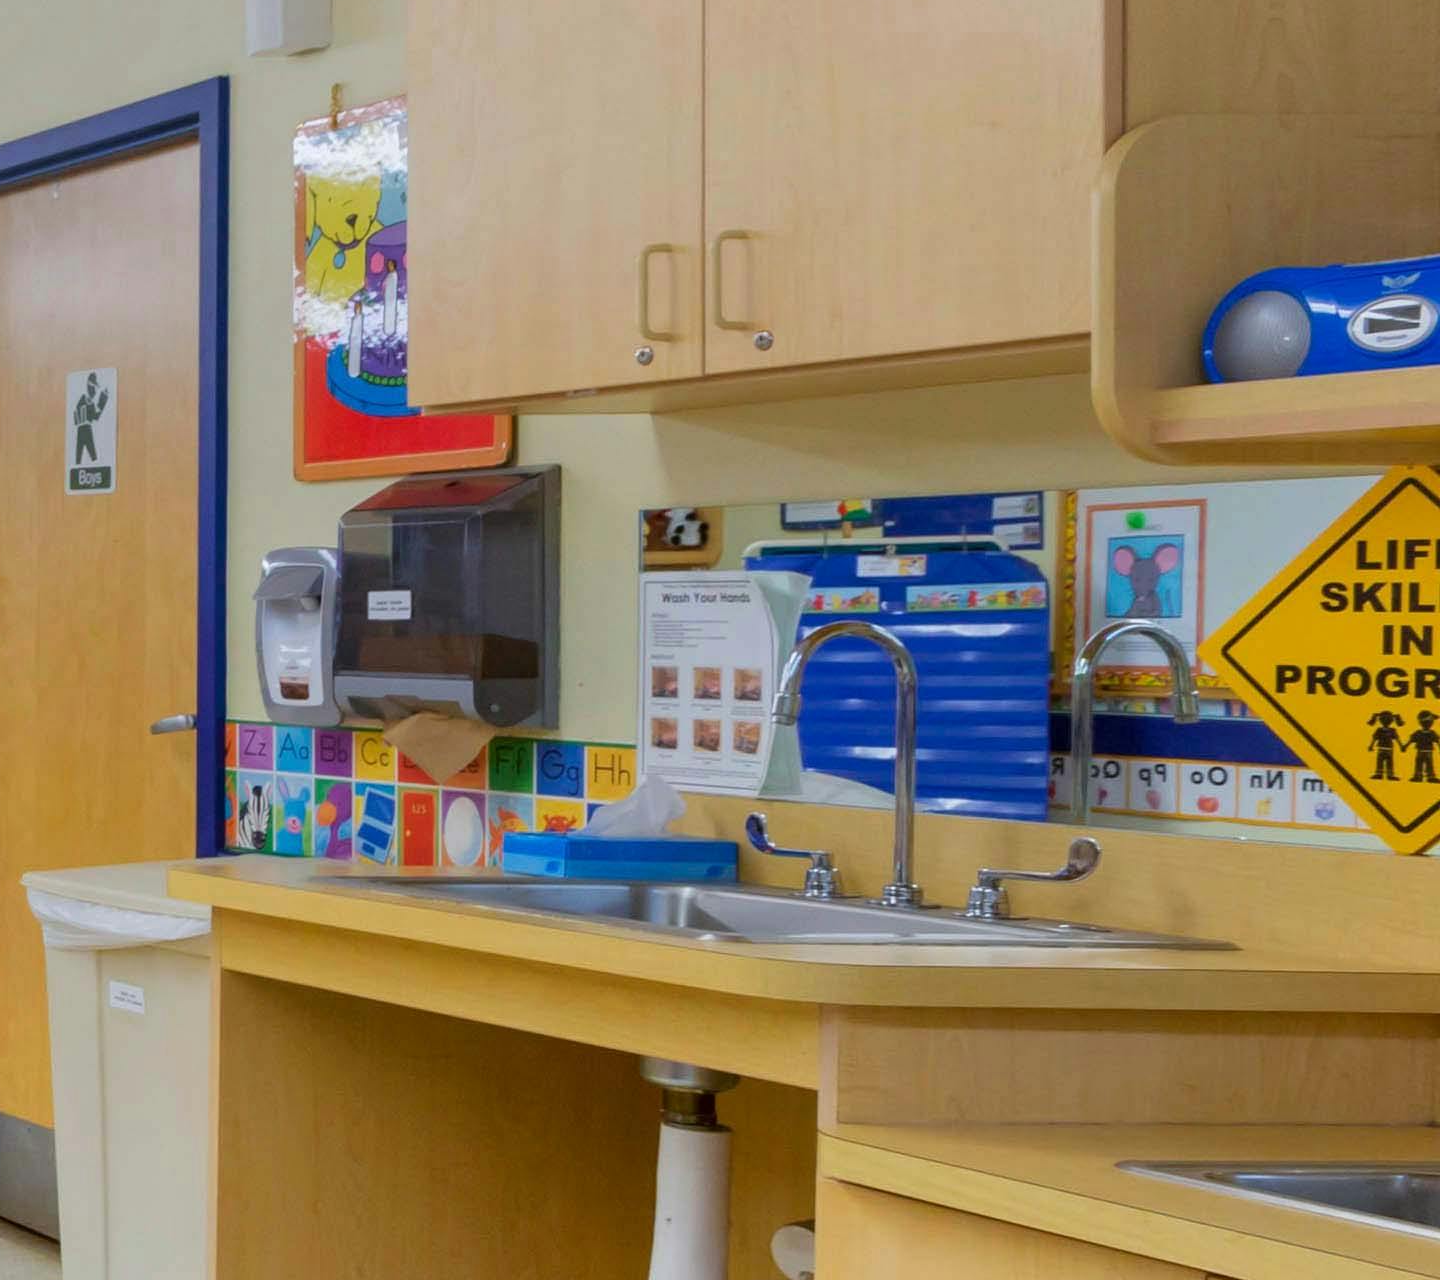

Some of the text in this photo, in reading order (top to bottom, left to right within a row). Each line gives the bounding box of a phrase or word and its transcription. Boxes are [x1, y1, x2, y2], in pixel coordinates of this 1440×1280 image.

[79, 470, 102, 487] Boys
[1356, 538, 1440, 570] LIF
[661, 593, 751, 603] Wash Your Hands
[1382, 624, 1434, 656] IN
[244, 729, 267, 757] Zz
[279, 733, 309, 759] Aa
[320, 735, 348, 762] Bb
[361, 738, 389, 767] Cc
[495, 745, 526, 775] Ff
[541, 749, 579, 796] Gg
[594, 753, 631, 785] Hh
